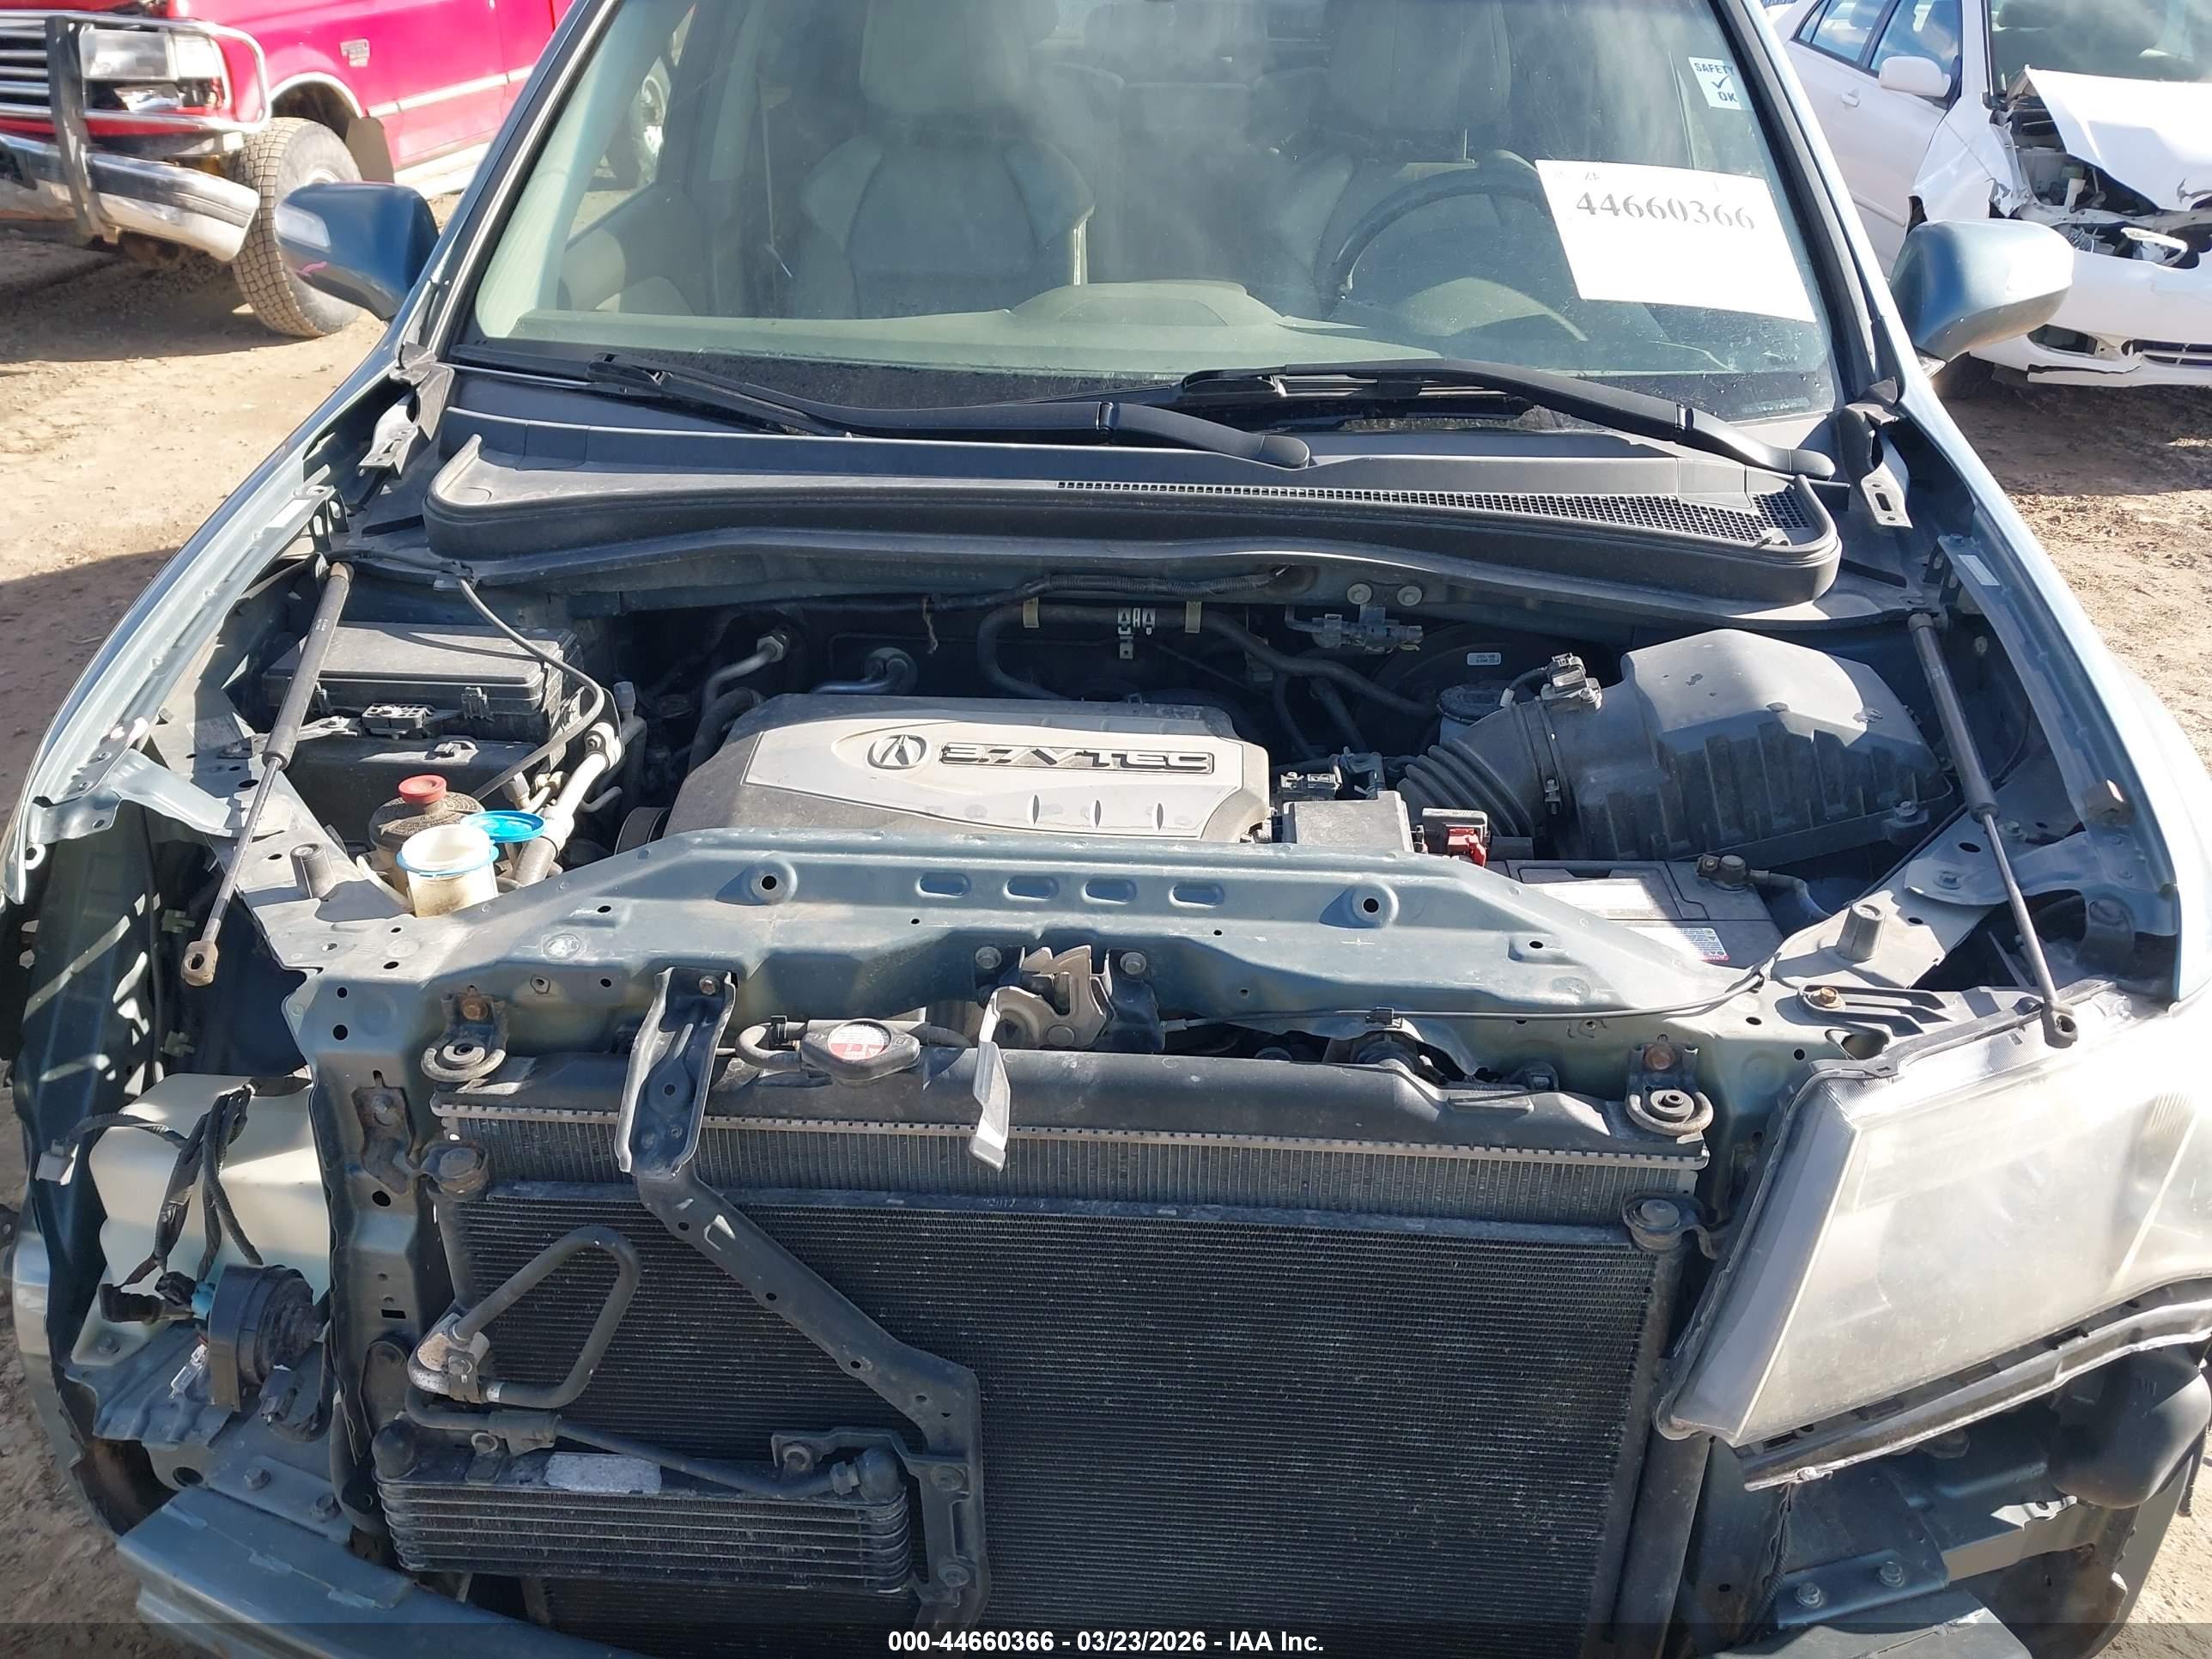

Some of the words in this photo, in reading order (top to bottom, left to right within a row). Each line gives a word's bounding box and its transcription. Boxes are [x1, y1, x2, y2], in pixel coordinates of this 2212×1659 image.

[1694, 62, 1734, 76] SAFETY
[1717, 91, 1739, 103] OK
[1577, 191, 1756, 230] 44660366
